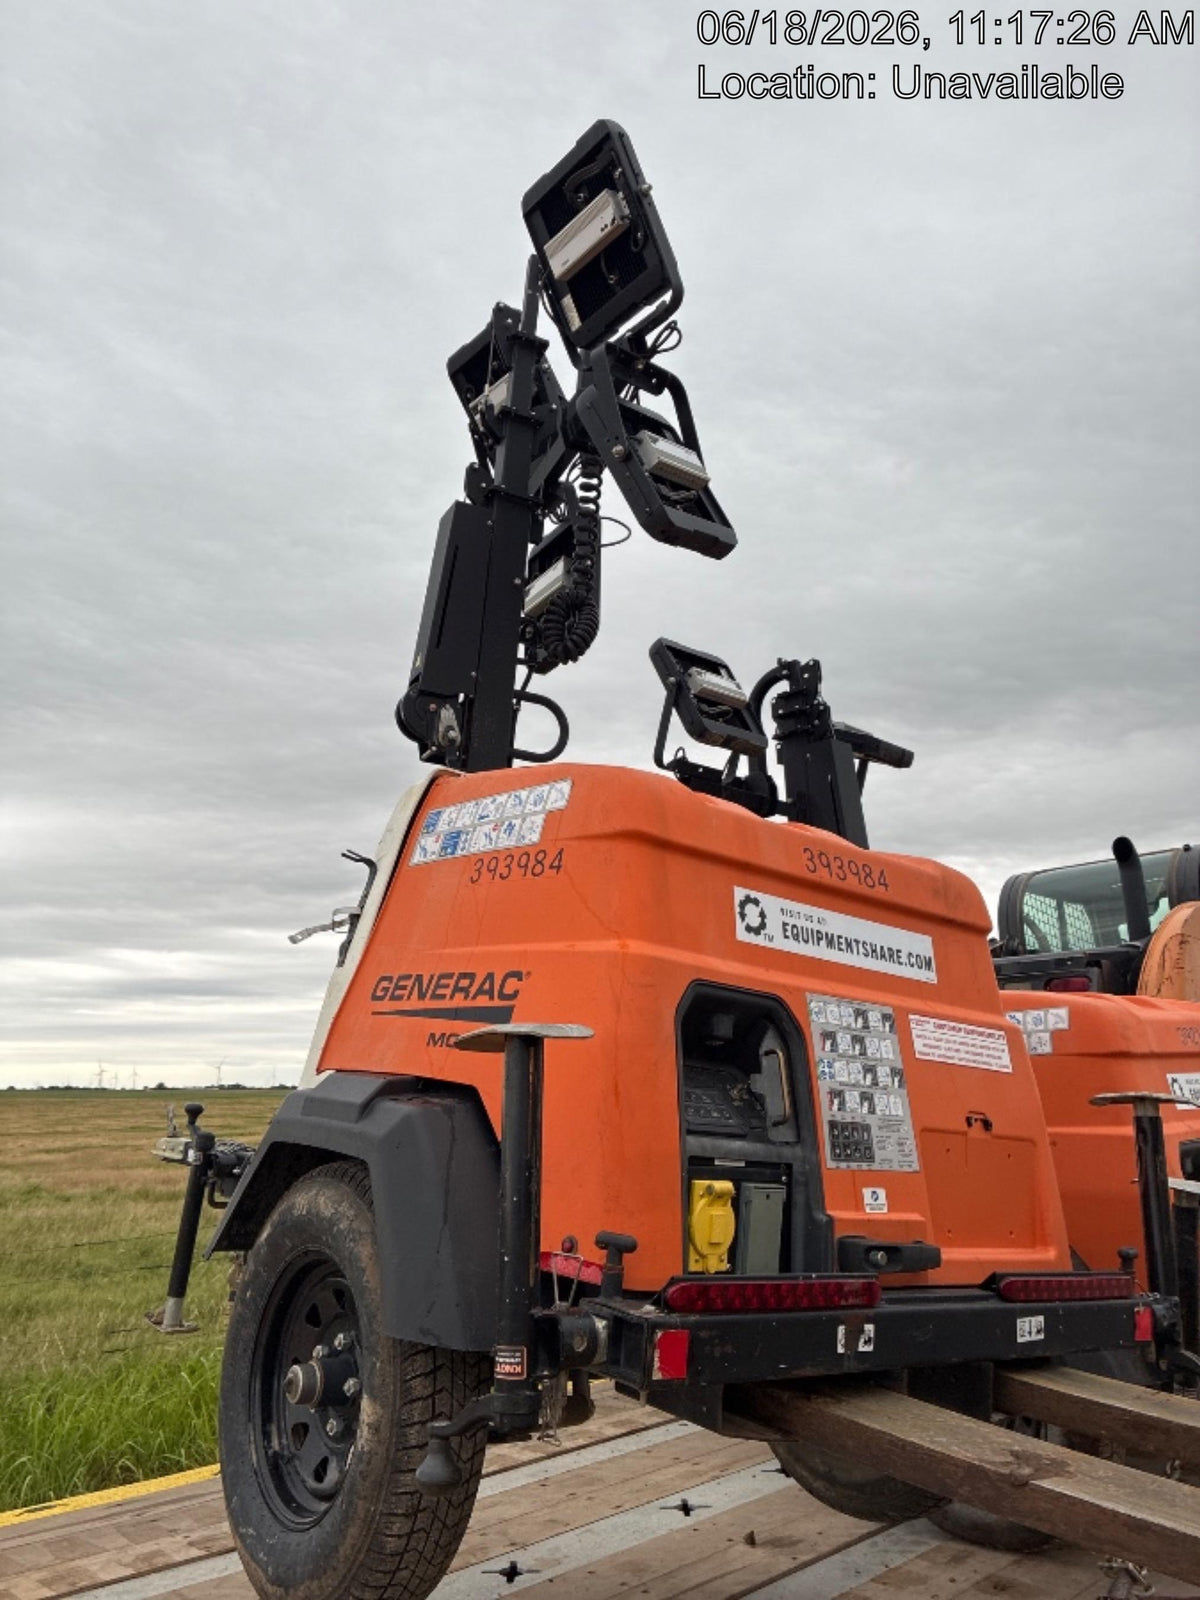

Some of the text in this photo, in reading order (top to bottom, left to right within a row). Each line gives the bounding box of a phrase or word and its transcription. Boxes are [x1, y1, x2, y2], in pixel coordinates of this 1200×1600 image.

[470, 848, 564, 884] 393984
[803, 847, 890, 891] 393984
[781, 920, 934, 973] EQUIPMENTSHARE.COM
[371, 970, 524, 1001] GENERAC
